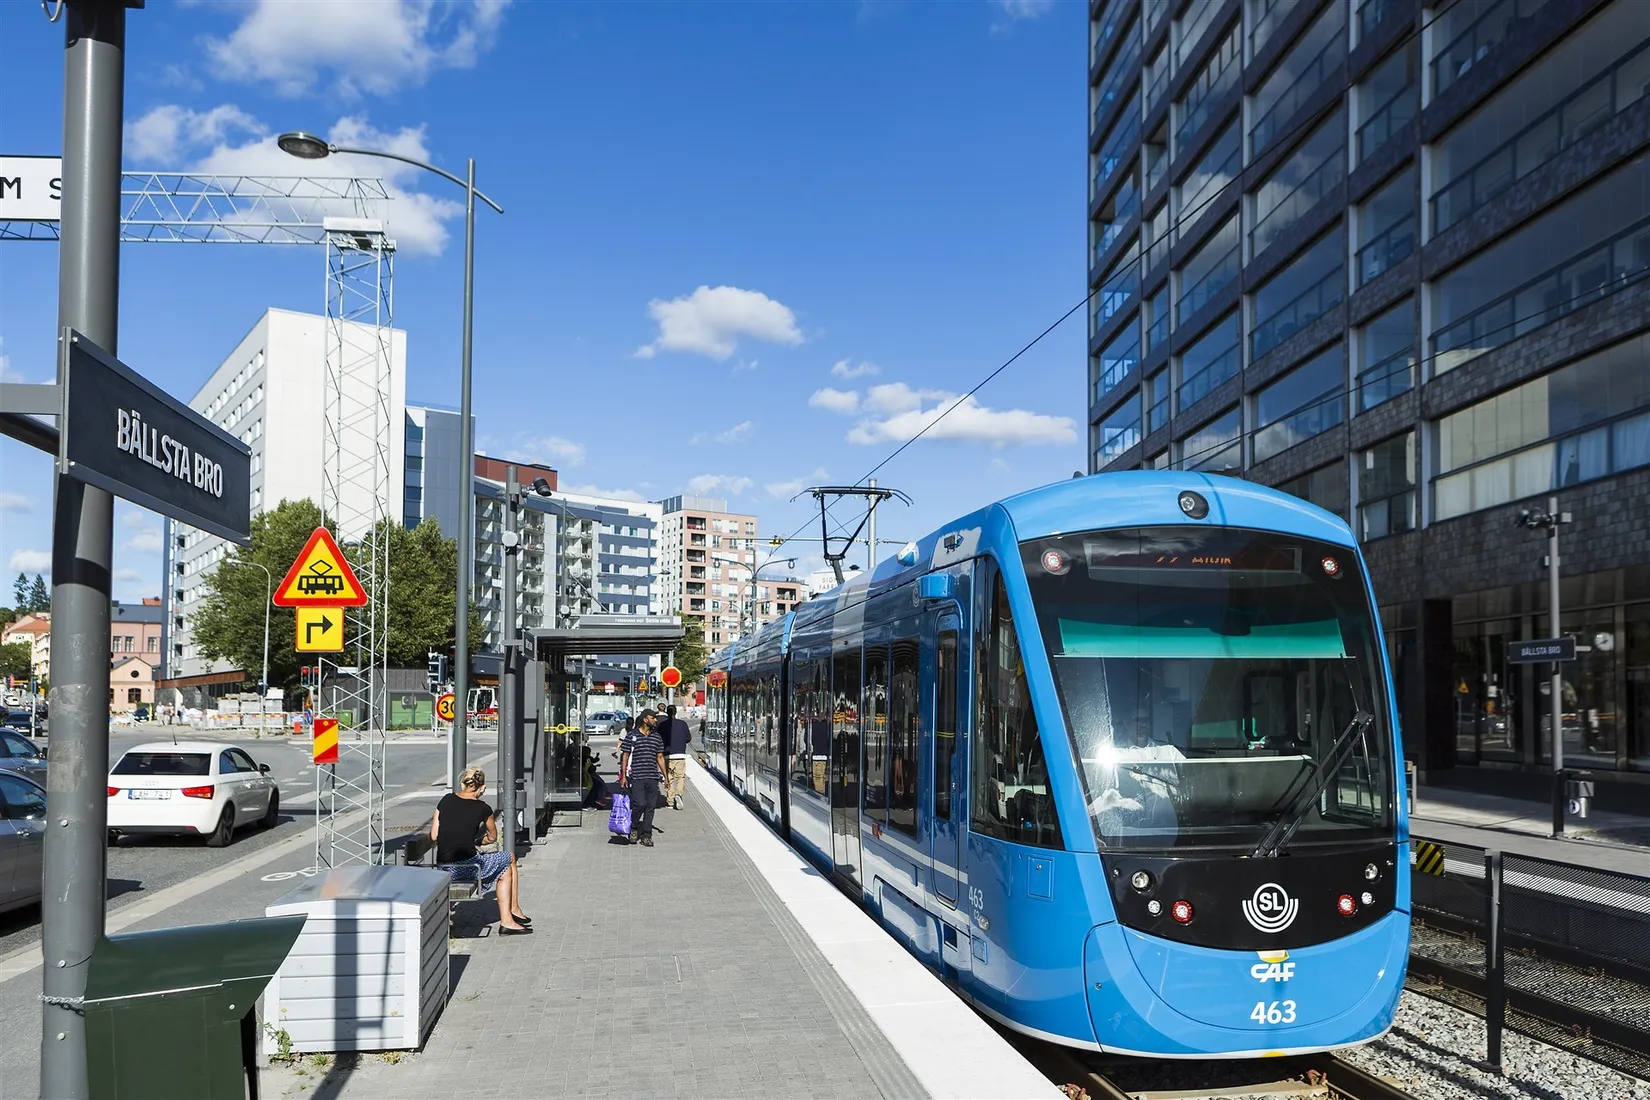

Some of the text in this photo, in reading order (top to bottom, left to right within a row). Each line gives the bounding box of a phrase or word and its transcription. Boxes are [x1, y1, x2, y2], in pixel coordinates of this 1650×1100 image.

[117, 408, 223, 498] BÄLLSTA BRO
[1521, 645, 1561, 656] BÄLLSTA BRO
[968, 885, 984, 910] 463
[1259, 892, 1283, 911] SL
[1250, 962, 1296, 983] CAF
[1250, 1000, 1297, 1025] 463
